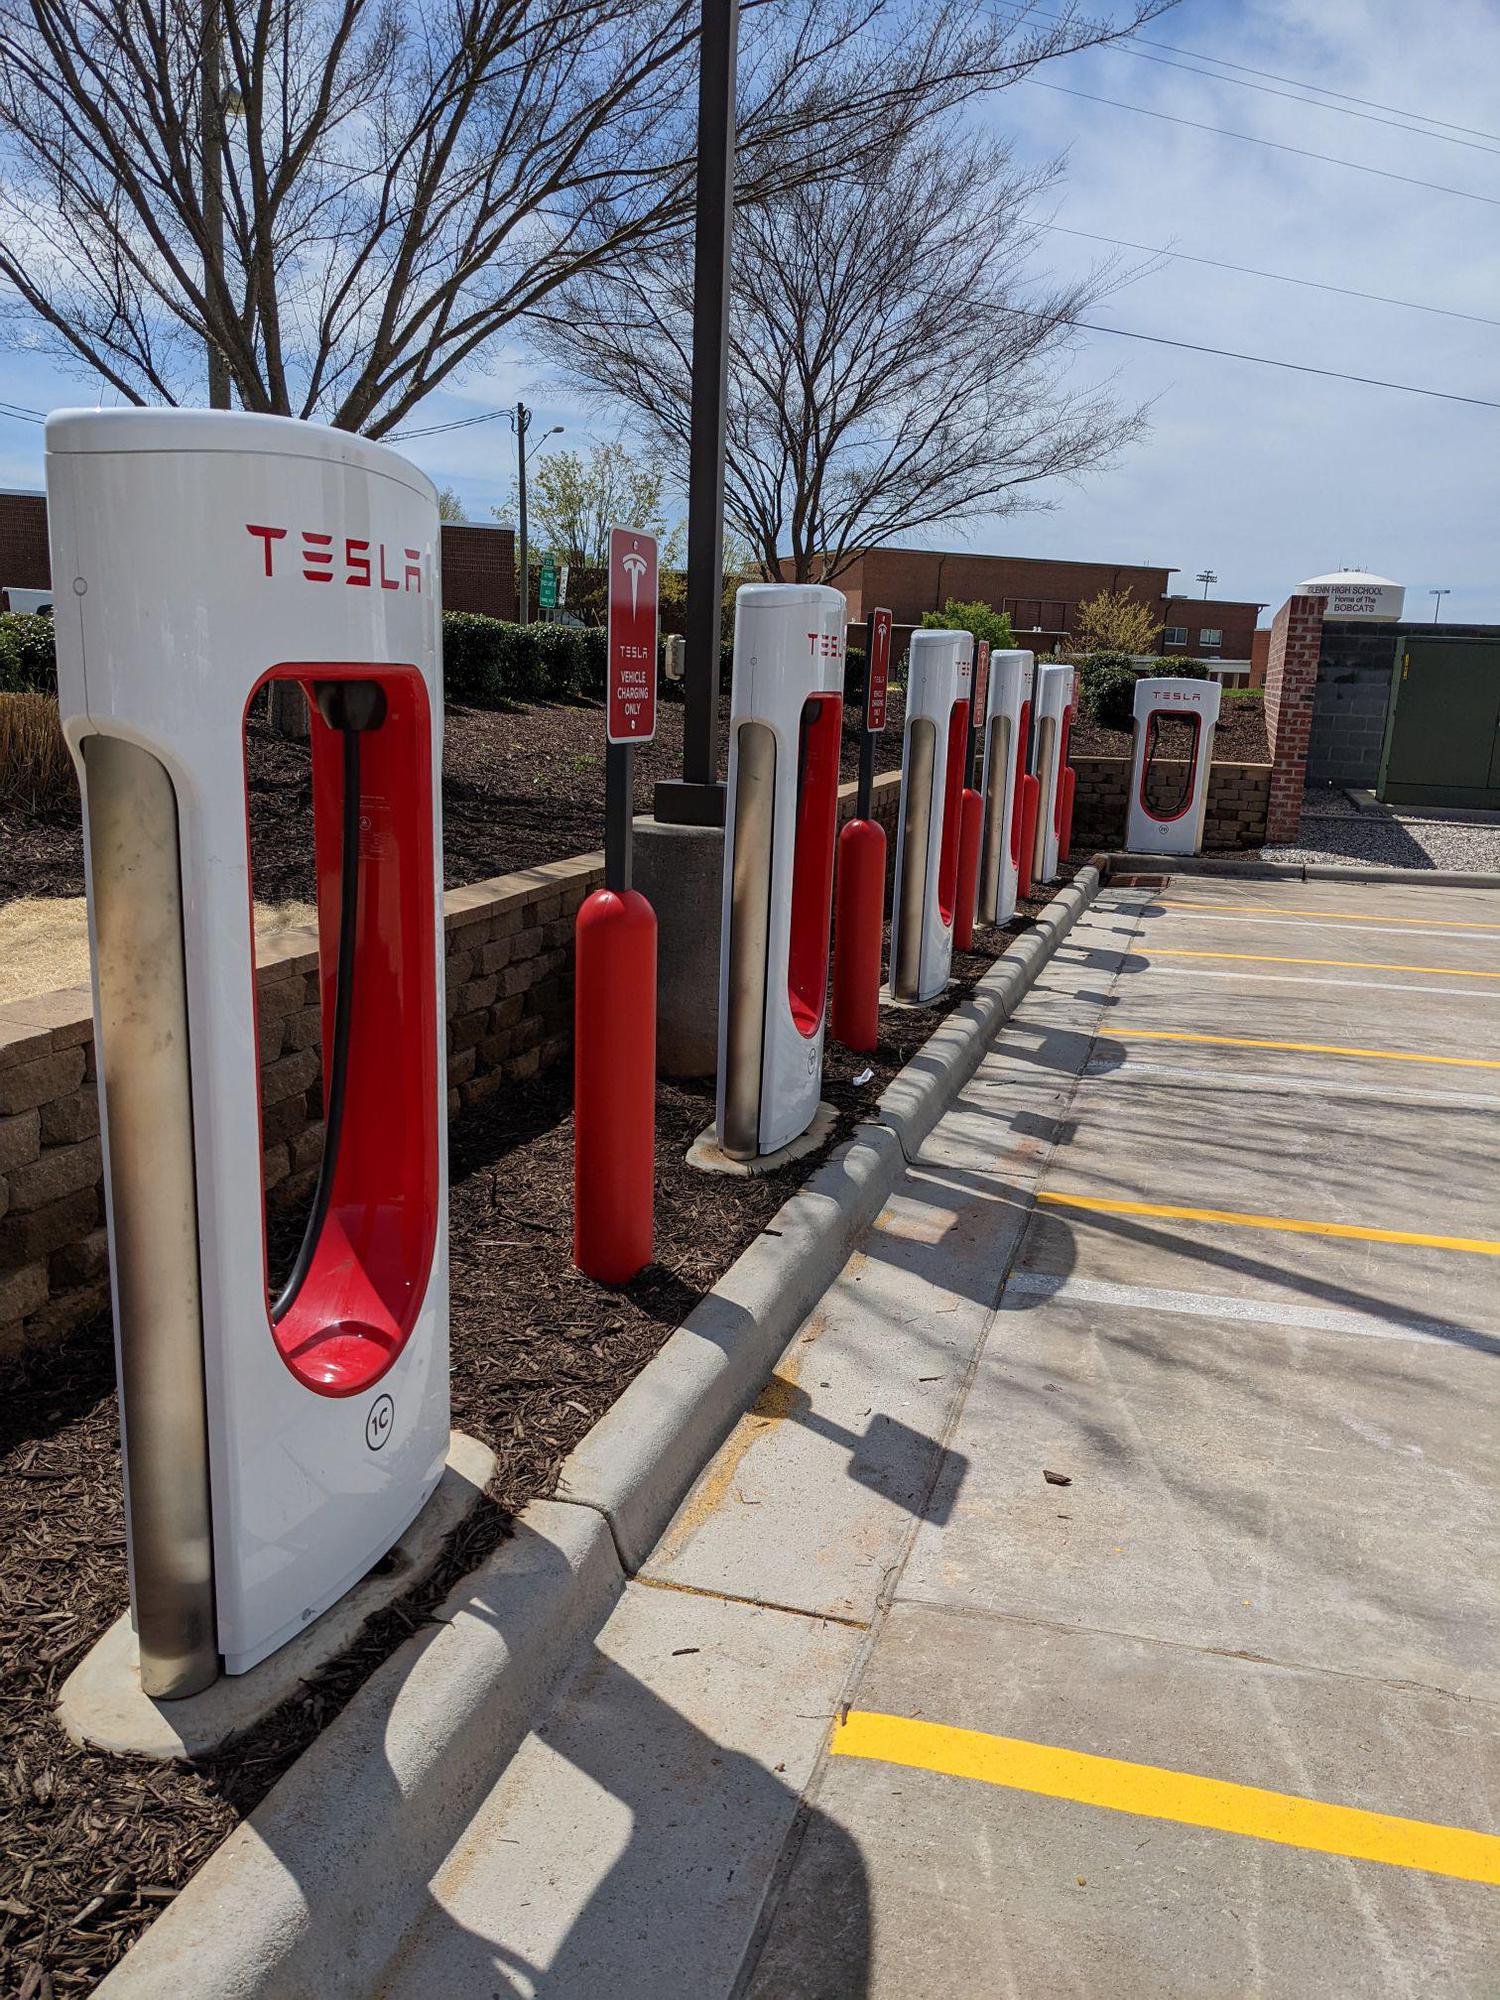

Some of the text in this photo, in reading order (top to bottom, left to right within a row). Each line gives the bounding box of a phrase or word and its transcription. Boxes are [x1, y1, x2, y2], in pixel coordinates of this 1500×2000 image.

[246, 524, 421, 593] TESLA
[1331, 586, 1351, 594] HIGH
[1352, 586, 1383, 595] SCHOOL
[1334, 595, 1355, 603] Home
[1364, 596, 1376, 604] The
[1333, 603, 1375, 613] BOBCATS
[620, 645, 648, 659] TESLA
[620, 671, 646, 683] VEHICLE
[617, 687, 649, 700] CHARGING
[1153, 691, 1201, 701] TESLA
[624, 703, 641, 715] ONLY
[372, 1407, 389, 1436] 1C
